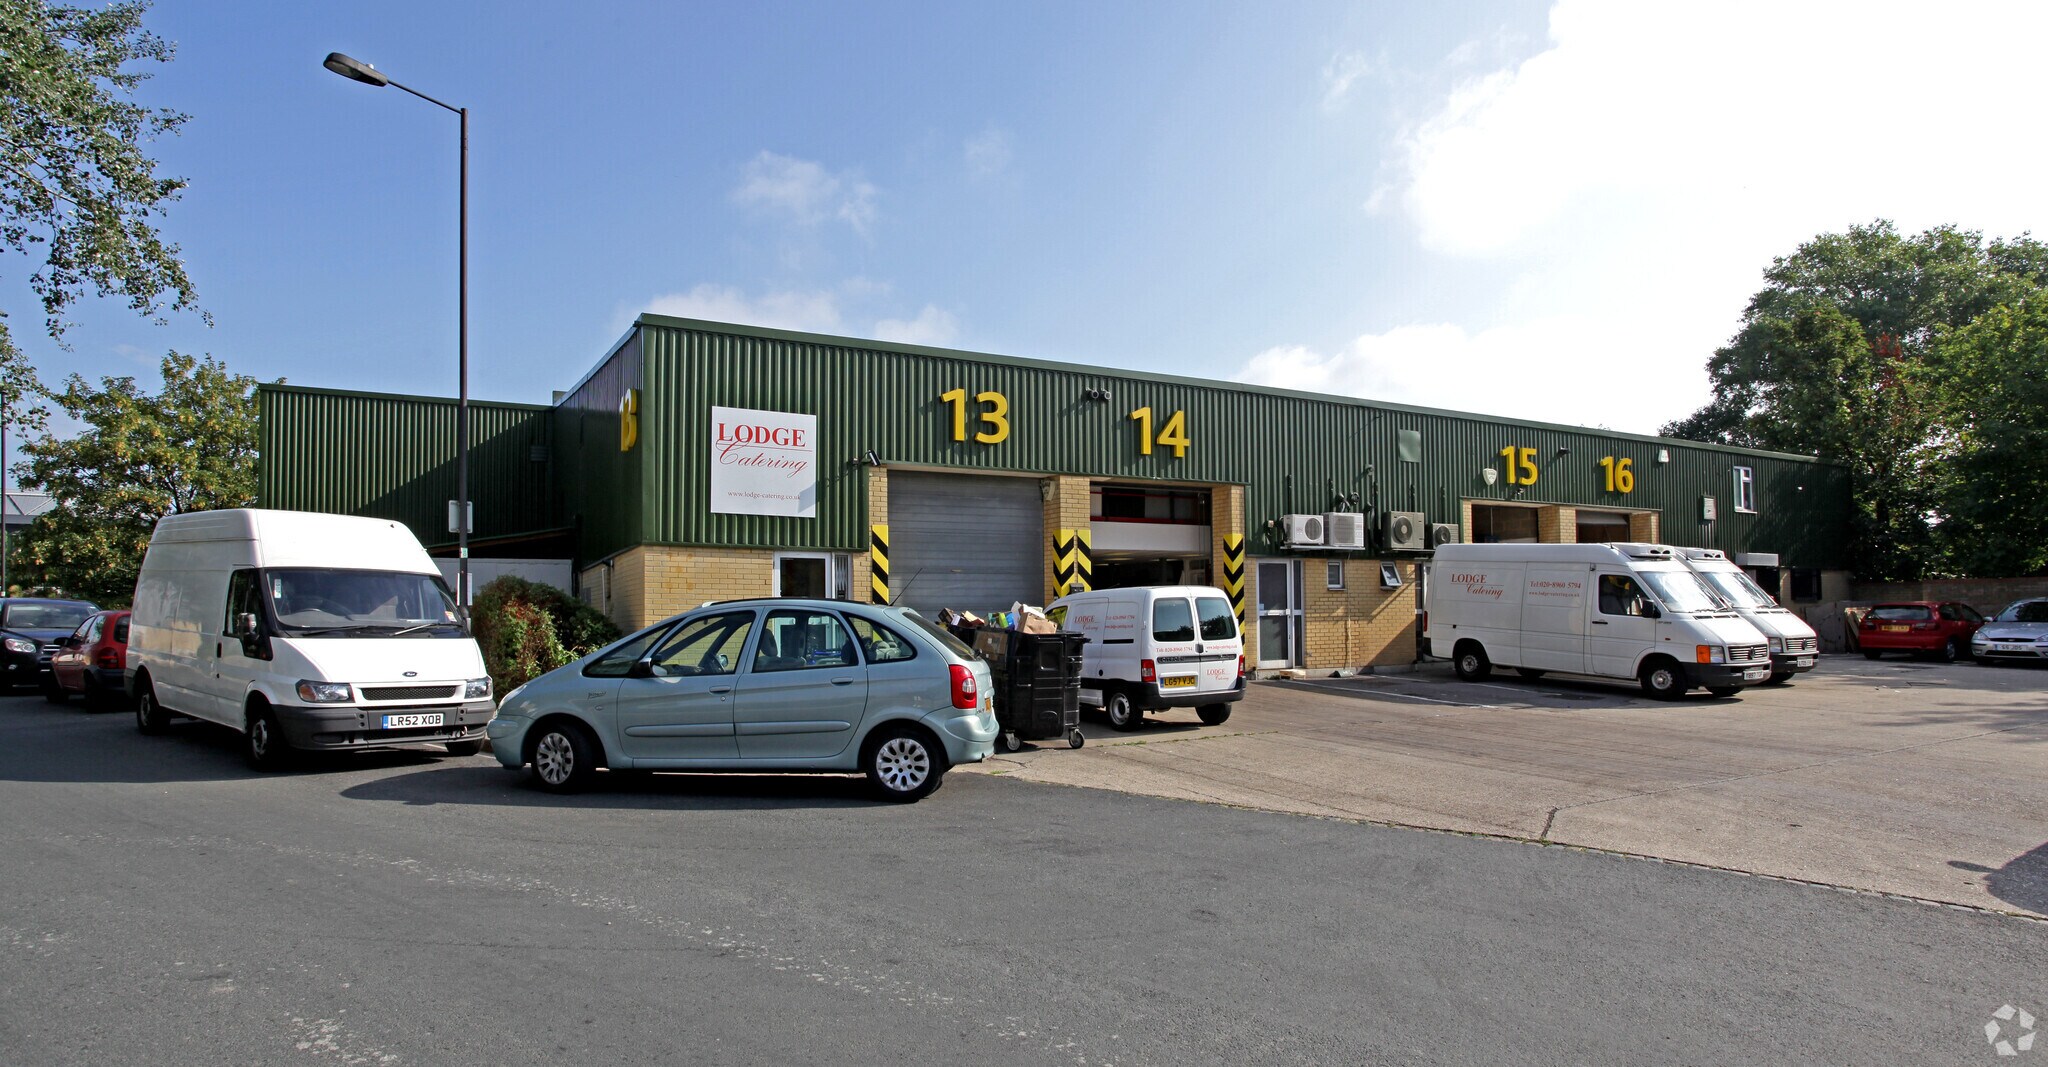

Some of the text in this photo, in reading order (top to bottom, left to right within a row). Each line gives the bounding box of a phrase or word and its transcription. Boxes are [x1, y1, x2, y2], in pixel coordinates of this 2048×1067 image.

[940, 388, 1010, 444] 13
[717, 422, 807, 448] LODGE
[1129, 406, 1191, 458] 14
[715, 437, 808, 479] Catering
[1501, 445, 1538, 486] 15
[1600, 456, 1634, 494] 16
[727, 490, 801, 501] www.lodge-catering.co.uk
[1451, 573, 1488, 584] LODGE
[1466, 584, 1504, 600] Catering
[1164, 677, 1181, 686] LG57
[1206, 668, 1226, 676] LODGE
[389, 715, 442, 727] LR52 XOB
